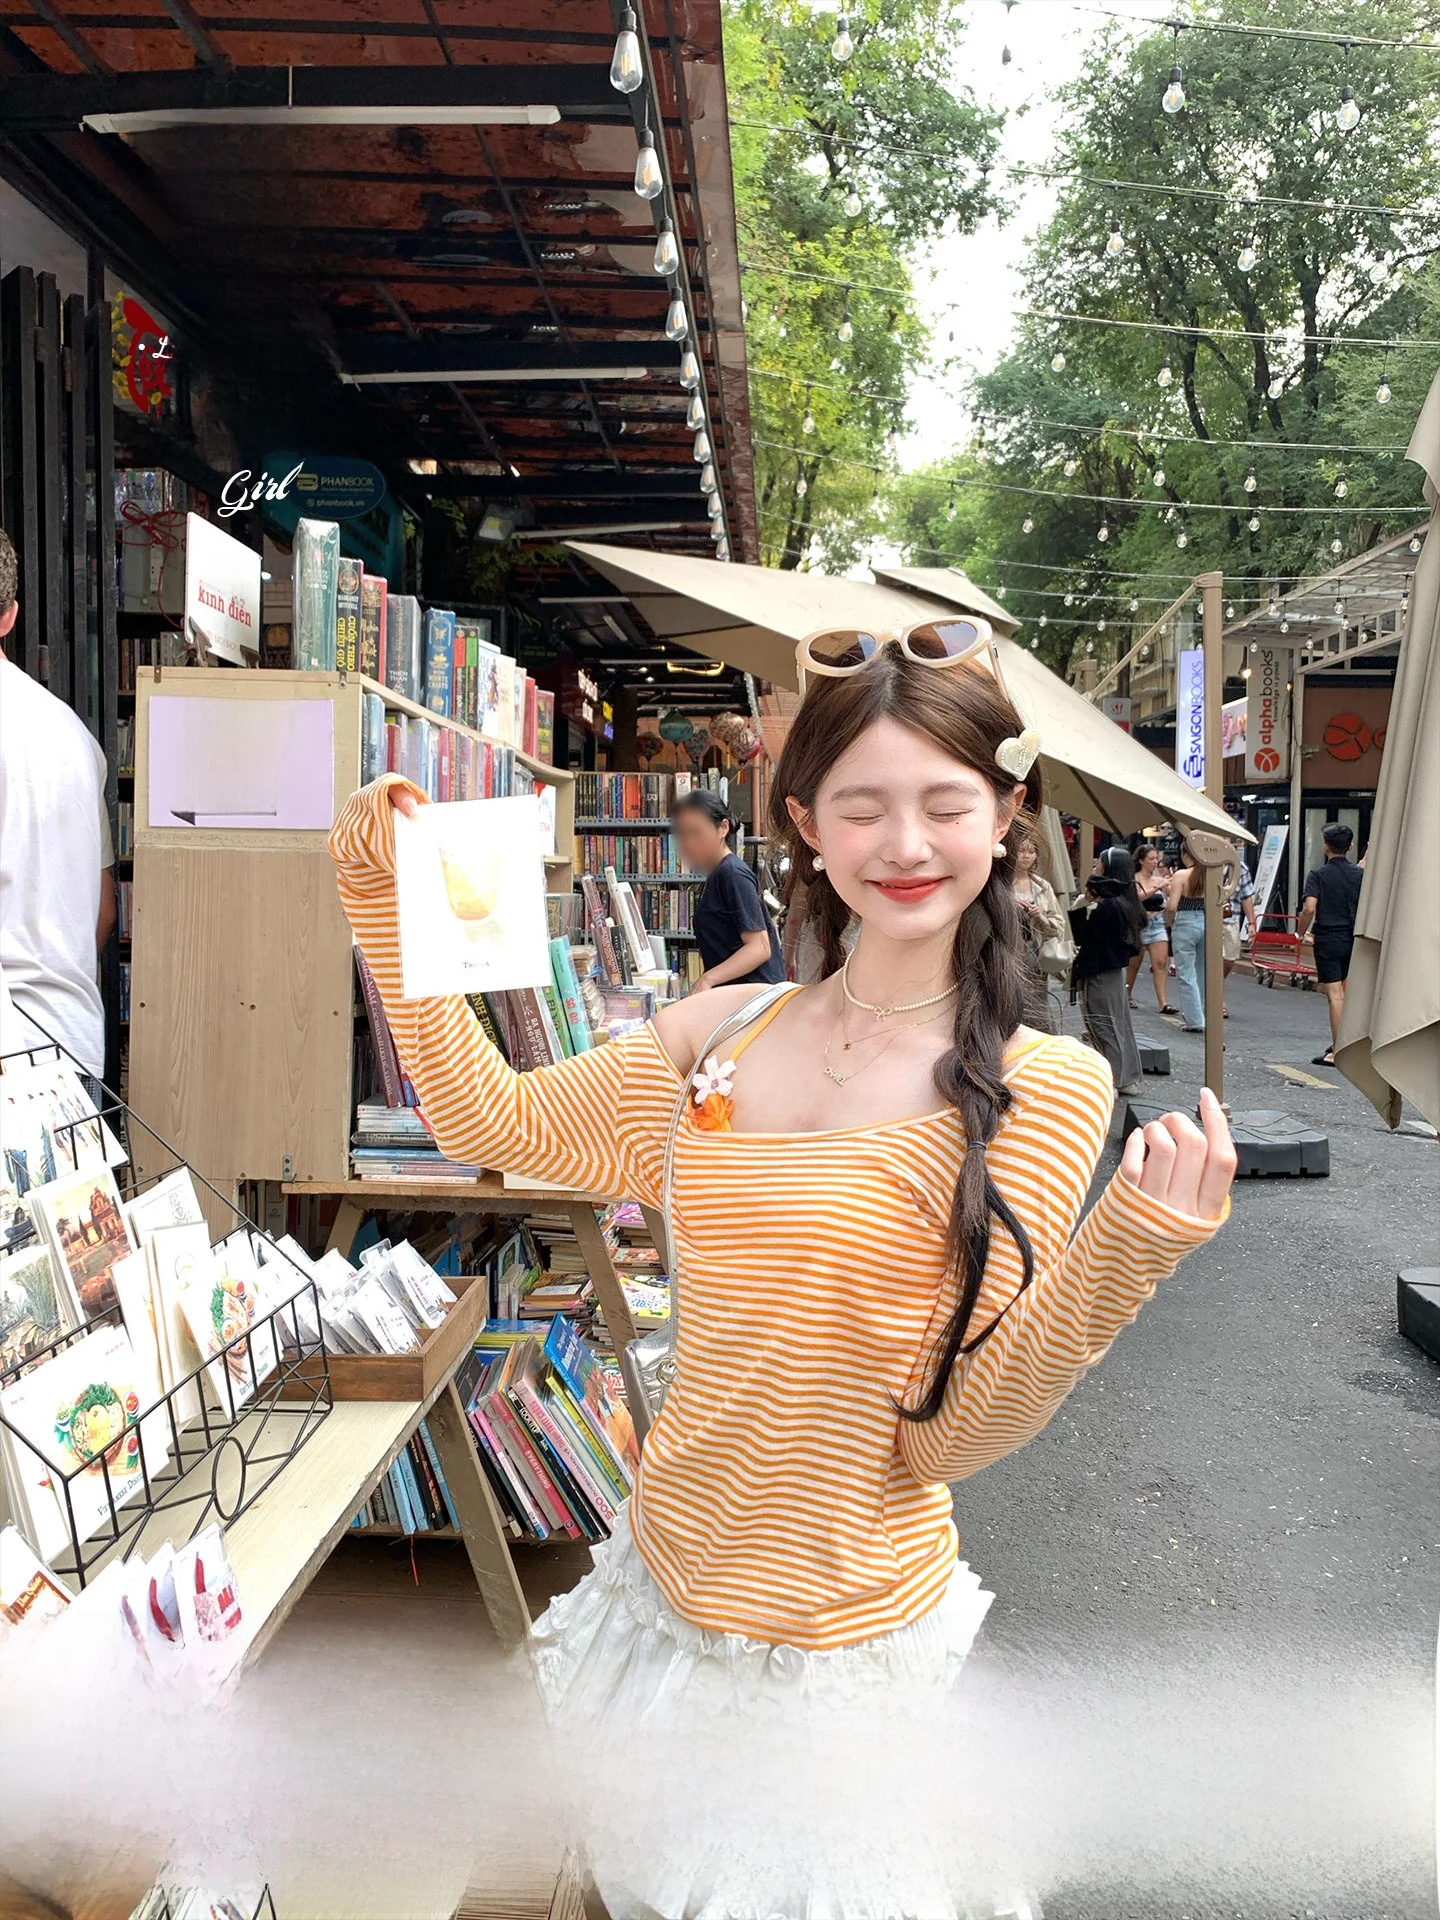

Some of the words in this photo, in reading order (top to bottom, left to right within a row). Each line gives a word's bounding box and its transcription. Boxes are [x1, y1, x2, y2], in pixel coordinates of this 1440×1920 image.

[320, 476, 374, 487] PHANBOOK
[198, 584, 225, 614] kinh
[337, 617, 348, 648] CHIẾU
[347, 615, 358, 644] CUỐN
[337, 649, 347, 668] GIÓ
[347, 646, 357, 671] THEO
[1190, 660, 1203, 753] SAIGONBOOKS
[1259, 649, 1274, 745] alphabooks
[525, 1450, 551, 1489] EVERYTHING
[594, 1495, 614, 1521] 500
